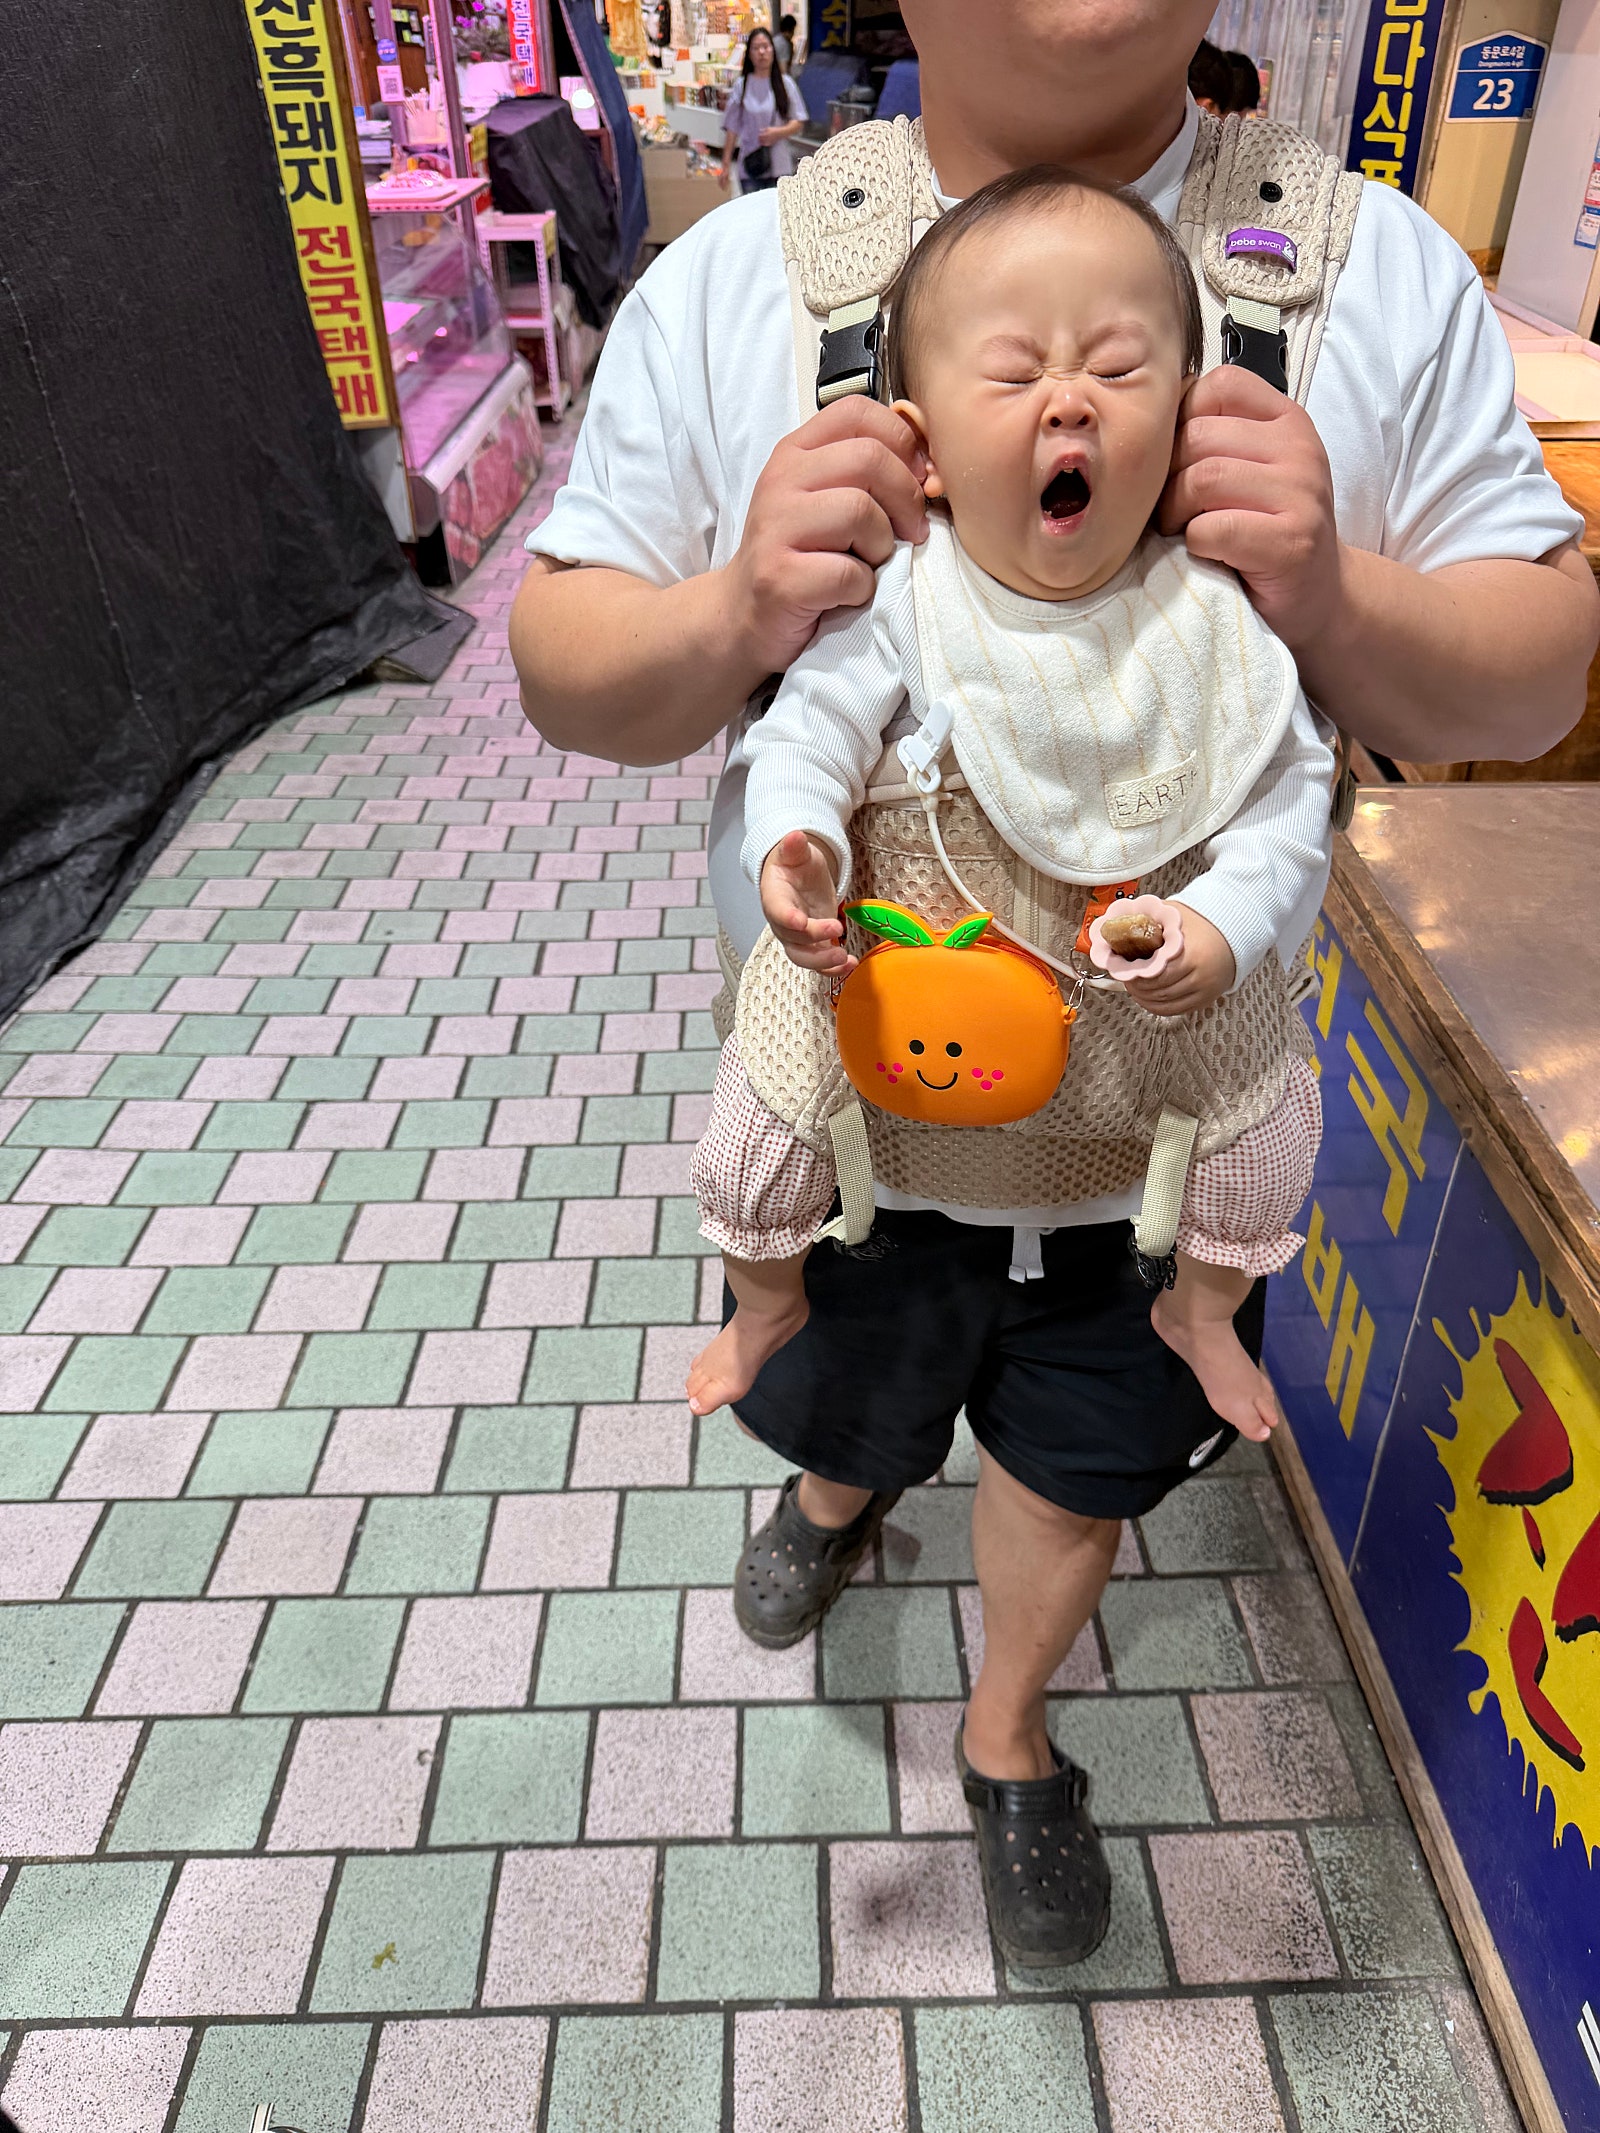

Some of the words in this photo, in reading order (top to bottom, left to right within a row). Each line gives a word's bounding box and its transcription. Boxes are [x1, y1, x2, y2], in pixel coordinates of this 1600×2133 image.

[255, 0, 343, 205] 산흑돼지
[1472, 78, 1515, 110] 23
[1480, 45, 1526, 60] 동문로4길
[1257, 239, 1282, 250] swan
[297, 226, 378, 415] 전국택배
[1301, 1199, 1376, 1442] 배
